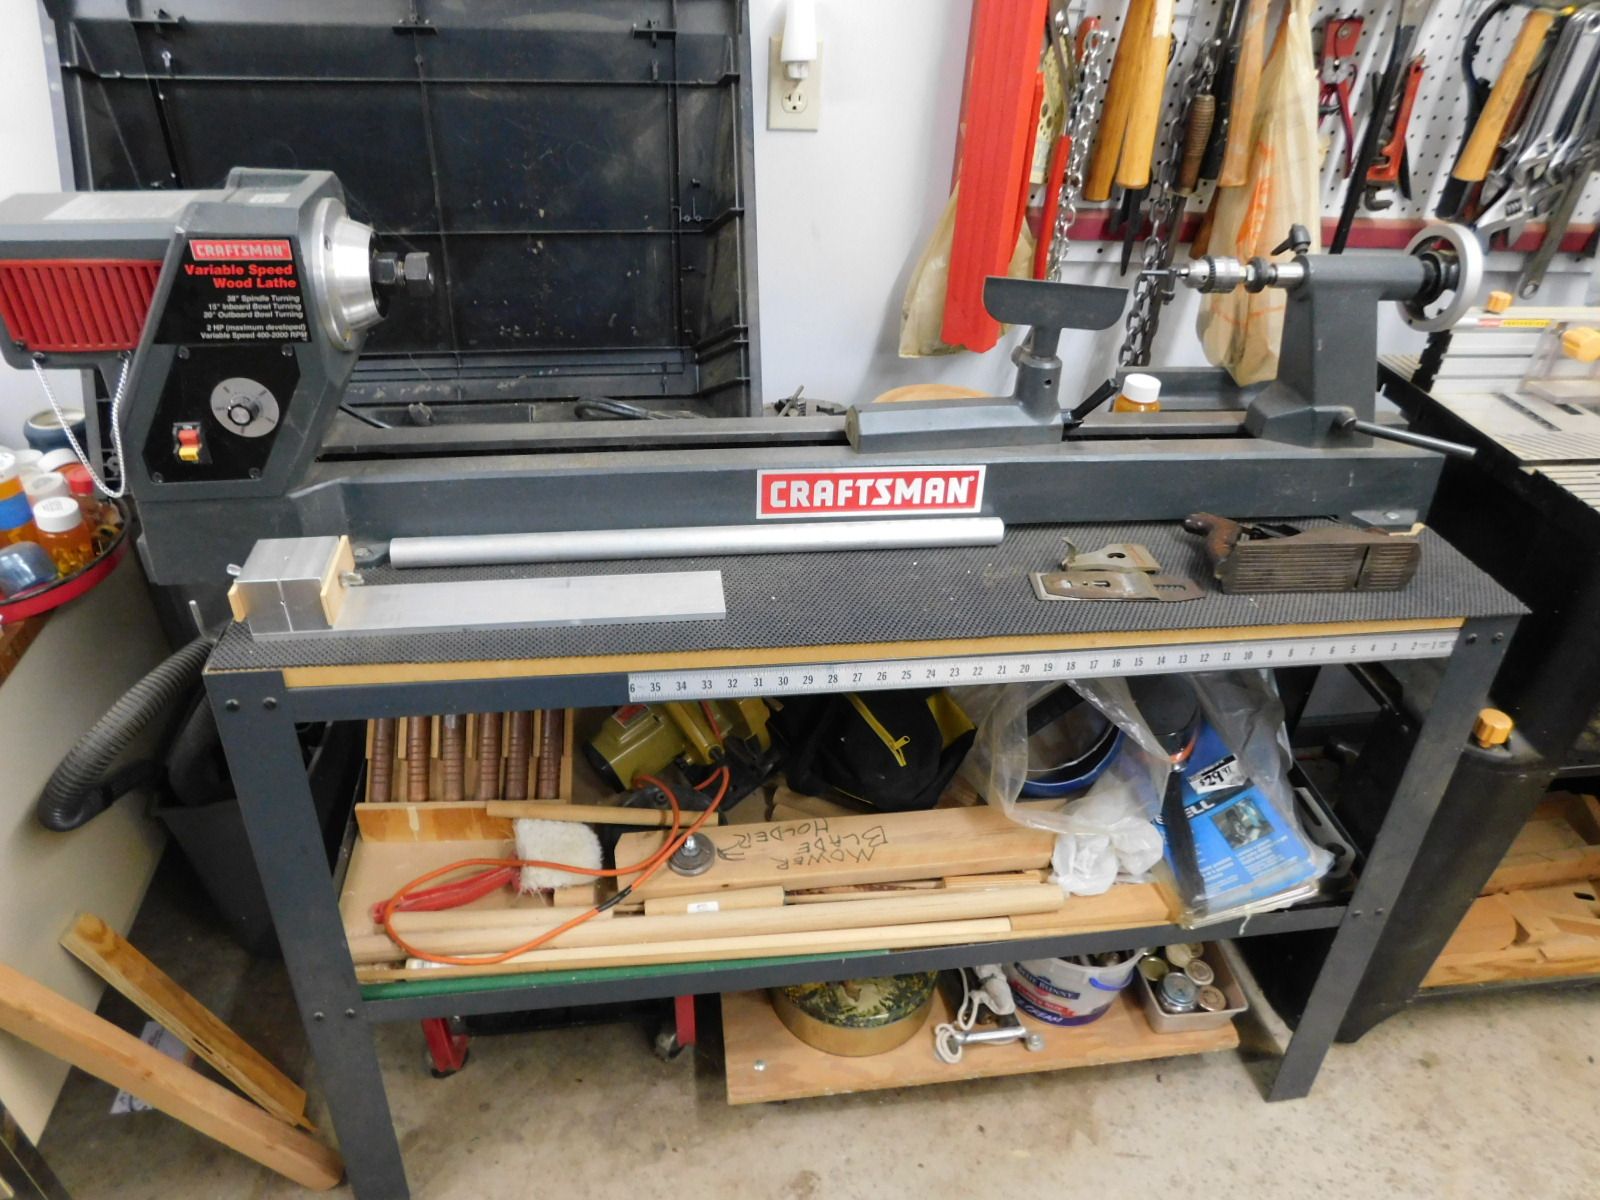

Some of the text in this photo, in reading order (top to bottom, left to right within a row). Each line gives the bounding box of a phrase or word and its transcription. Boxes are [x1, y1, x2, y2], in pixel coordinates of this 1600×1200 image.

[195, 244, 283, 257] CRAFTSMAN
[184, 264, 293, 277] Variable Speed
[213, 277, 297, 288] Wood Lathe
[241, 294, 269, 303] Spindle
[271, 294, 300, 303] Turning
[273, 303, 302, 312] Turning
[275, 311, 303, 320] Turning
[232, 332, 255, 340] Speed
[769, 476, 971, 508] CRAFTSMAN
[650, 682, 661, 692] 35
[676, 681, 687, 691] 34
[702, 680, 712, 689] 33
[727, 679, 738, 688] 32
[753, 677, 763, 687] 31
[778, 676, 788, 686] 30
[803, 675, 813, 685] 29
[828, 674, 838, 683] 28
[852, 673, 863, 682] 27
[877, 672, 887, 681] 26
[901, 670, 912, 679] 25
[926, 669, 936, 678] 24
[949, 668, 960, 677] 23
[973, 666, 983, 676] 22
[997, 665, 1006, 674] 21
[1019, 664, 1030, 673] 20
[1043, 663, 1053, 672] 19
[1066, 662, 1076, 670] 18
[1090, 660, 1098, 669] 17
[1112, 659, 1121, 668] 16
[1134, 657, 1143, 666] 15
[1157, 656, 1166, 665] 14
[1178, 654, 1187, 664] 13
[1200, 654, 1209, 662] 12
[1223, 652, 1231, 661] 11
[1244, 651, 1253, 660] 10
[733, 818, 829, 848] HOLDER
[799, 825, 889, 853] BLADE
[771, 847, 876, 870] MOWER
